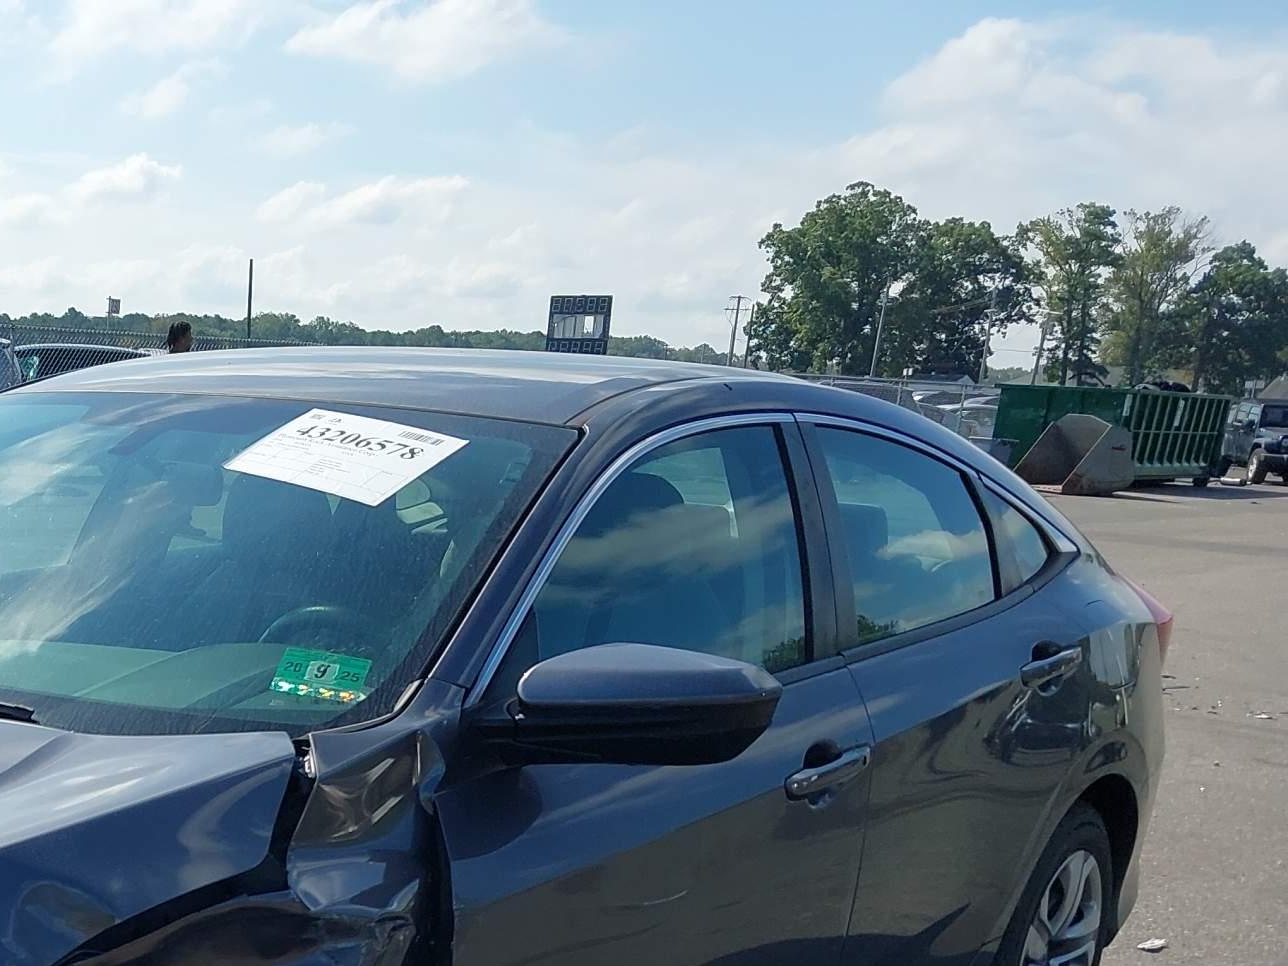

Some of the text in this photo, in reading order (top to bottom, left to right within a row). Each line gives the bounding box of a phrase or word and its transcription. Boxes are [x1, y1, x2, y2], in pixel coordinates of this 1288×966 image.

[296, 425, 424, 460] 43206578
[283, 661, 303, 673] 20
[339, 671, 360, 682] 25
